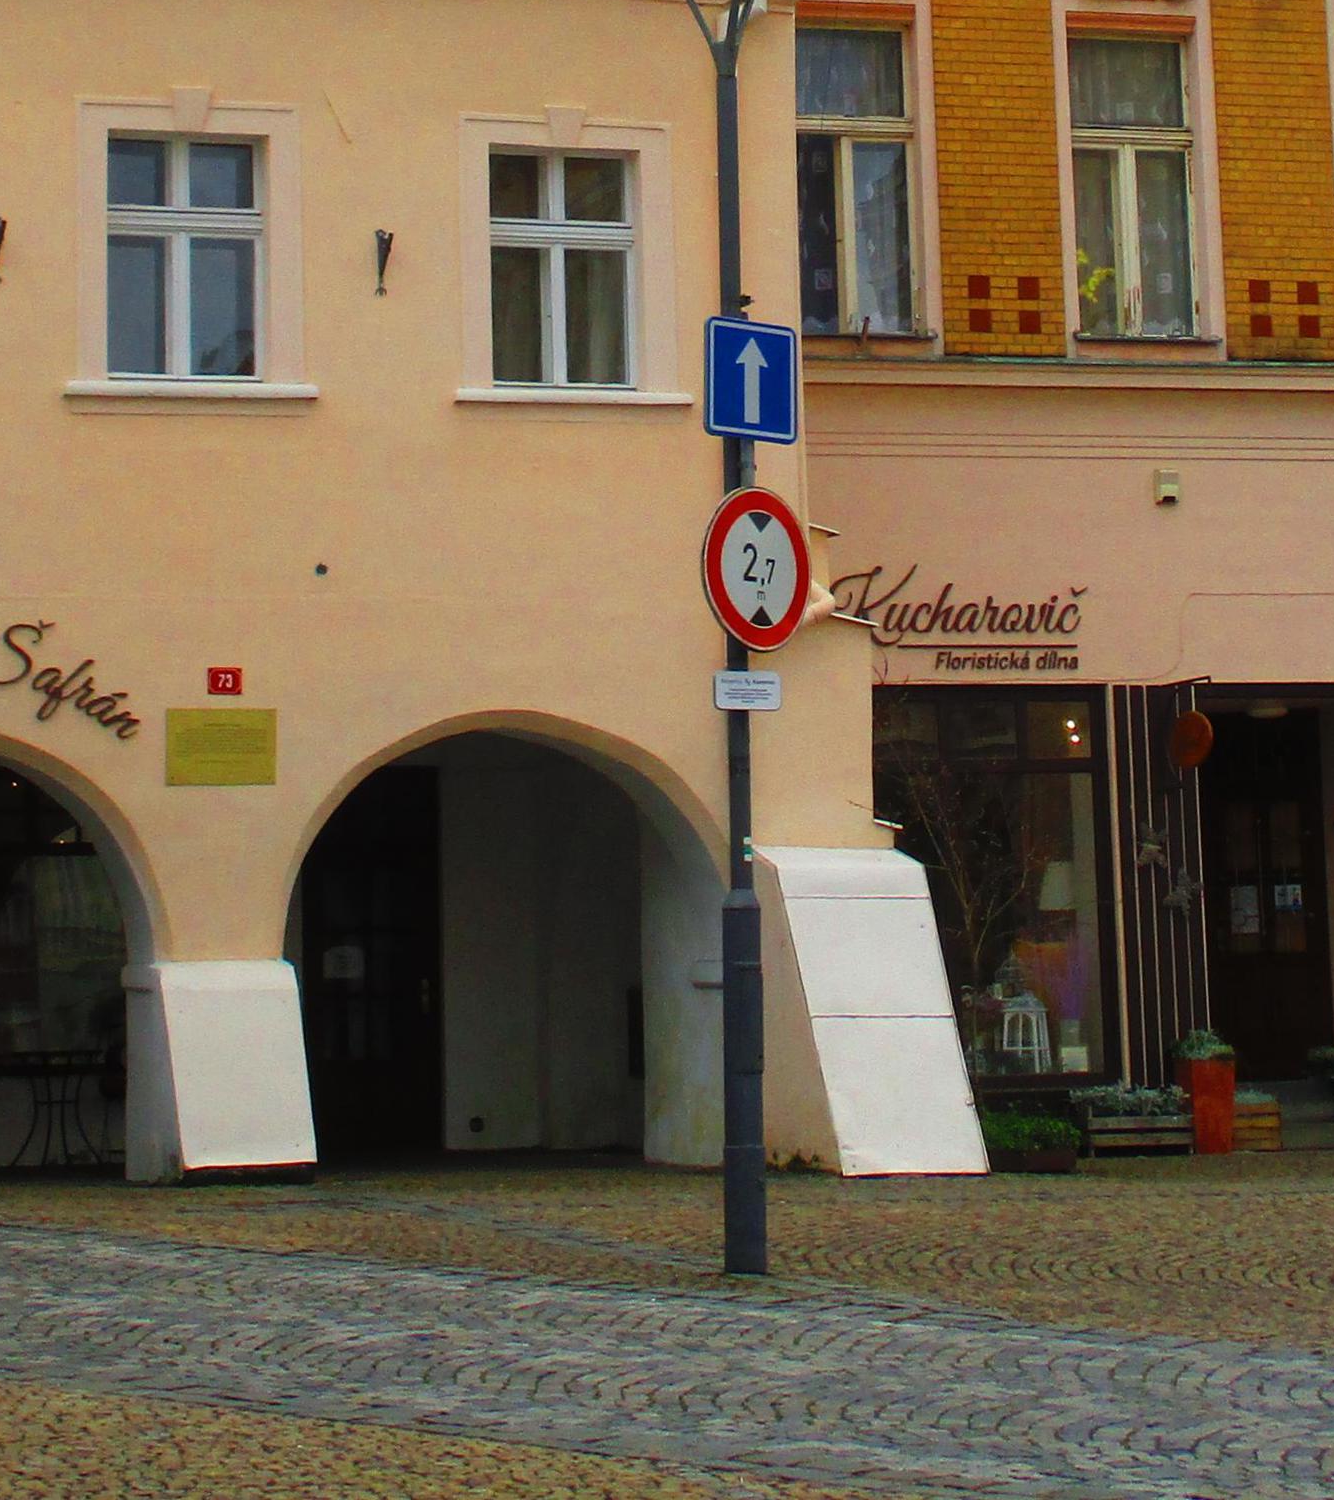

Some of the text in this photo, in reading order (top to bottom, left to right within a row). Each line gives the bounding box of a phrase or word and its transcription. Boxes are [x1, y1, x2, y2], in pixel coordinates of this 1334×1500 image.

[742, 543, 776, 587] 2,7
[829, 563, 1088, 646] Kucharovič
[935, 651, 1079, 670] Floristická dílna
[218, 674, 233, 688] 73
